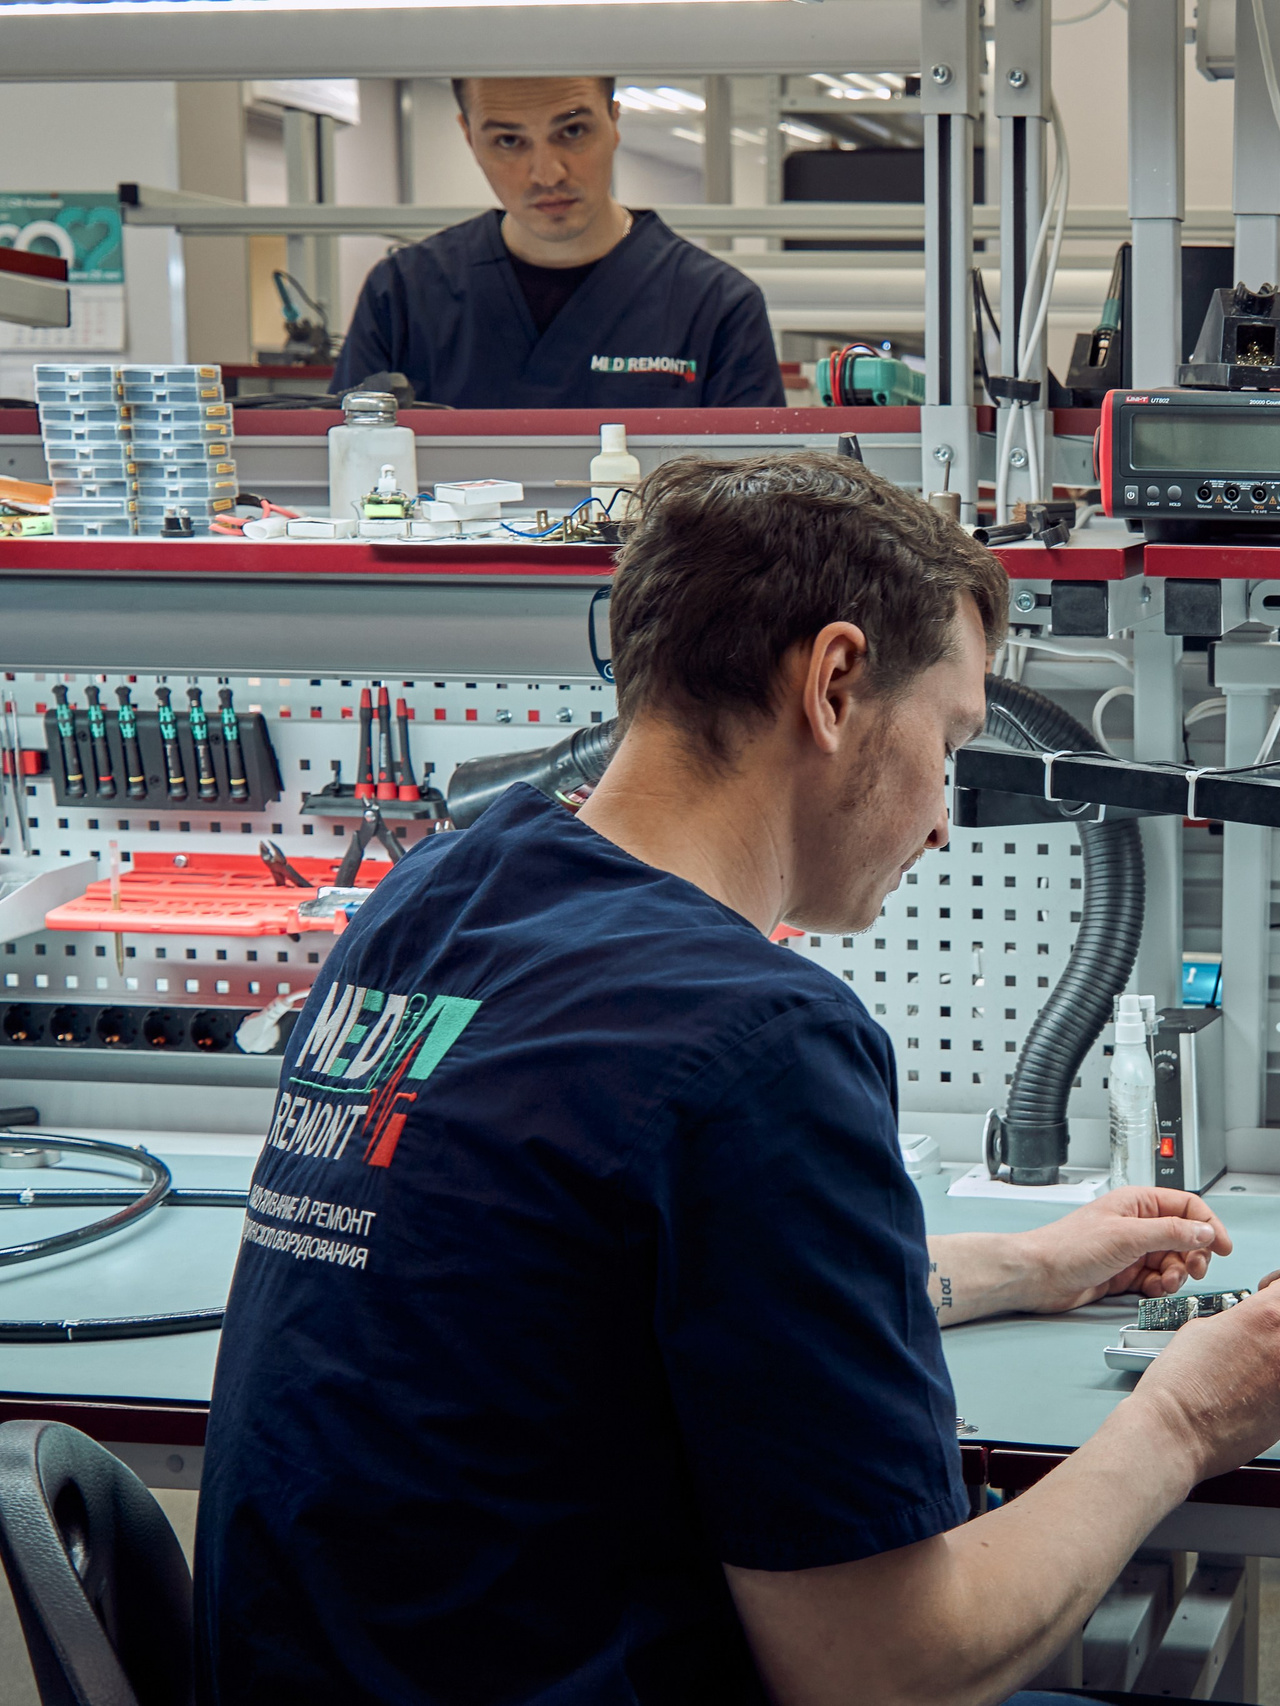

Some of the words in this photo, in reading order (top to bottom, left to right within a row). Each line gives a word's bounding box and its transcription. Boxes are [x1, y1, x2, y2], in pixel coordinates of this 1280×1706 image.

[295, 981, 408, 1080] MED
[268, 1092, 369, 1160] REMONT
[306, 1201, 377, 1237] РЕМОНТ
